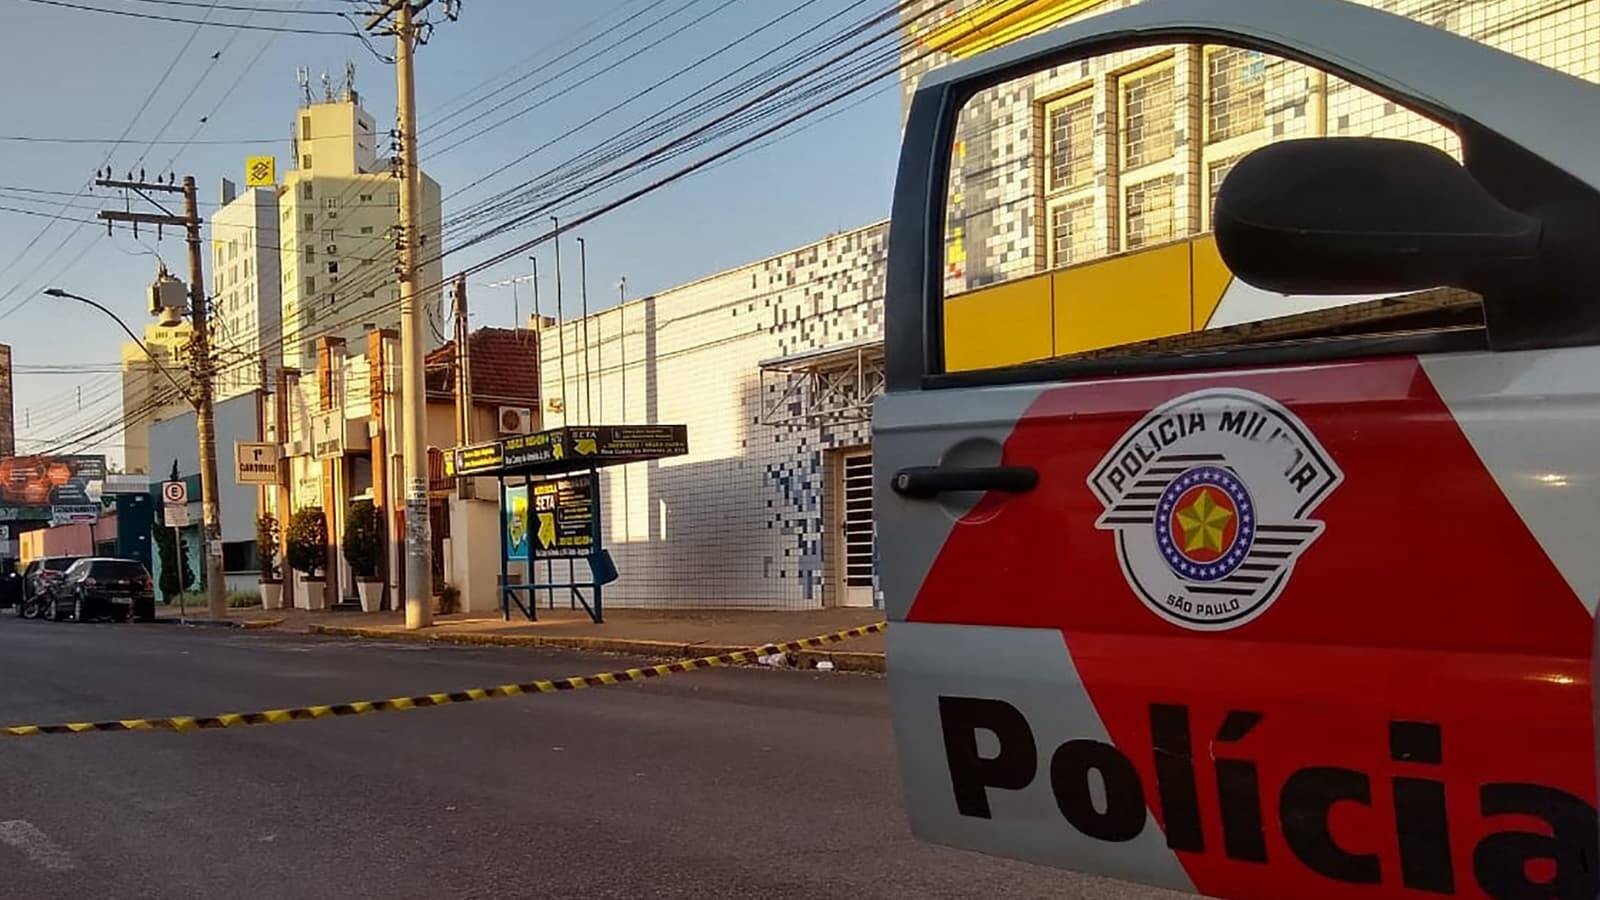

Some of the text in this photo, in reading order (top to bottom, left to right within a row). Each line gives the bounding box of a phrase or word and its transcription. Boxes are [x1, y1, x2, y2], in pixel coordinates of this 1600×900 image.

[171, 487, 179, 497] E
[536, 494, 555, 511] SETA
[1167, 594, 1239, 616] SÃO PAULO
[938, 695, 1600, 900] Polícia
